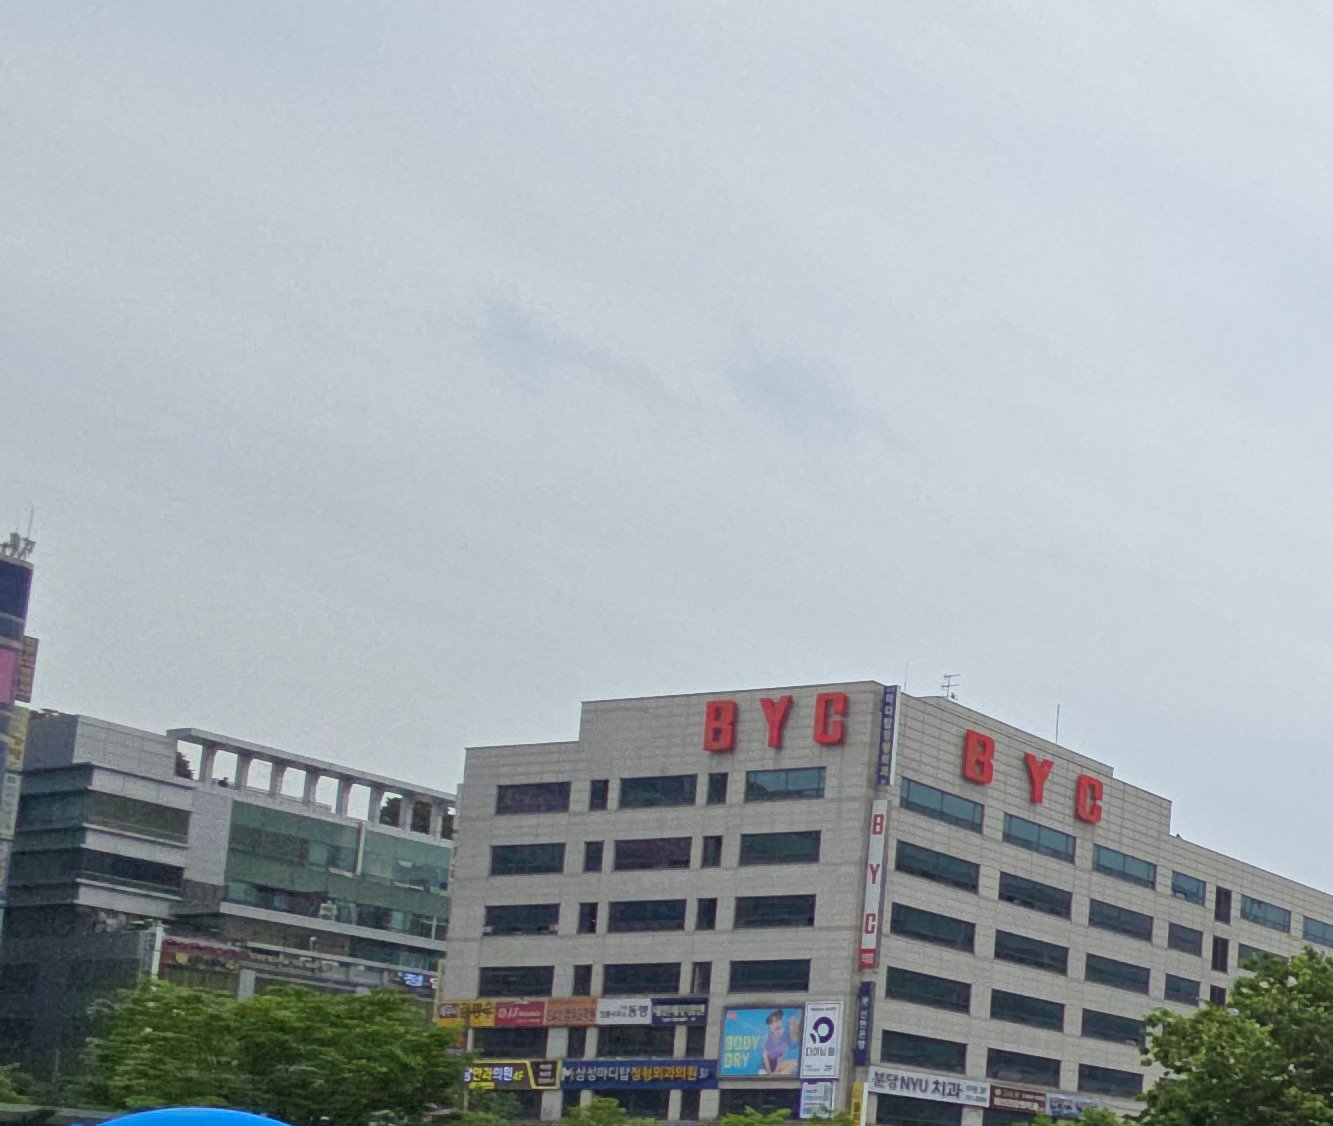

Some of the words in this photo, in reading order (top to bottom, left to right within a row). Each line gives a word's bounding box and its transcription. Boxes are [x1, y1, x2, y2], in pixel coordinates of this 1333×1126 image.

[703, 691, 848, 753] BYC
[962, 729, 1103, 824] BYC
[864, 814, 884, 934] BYC
